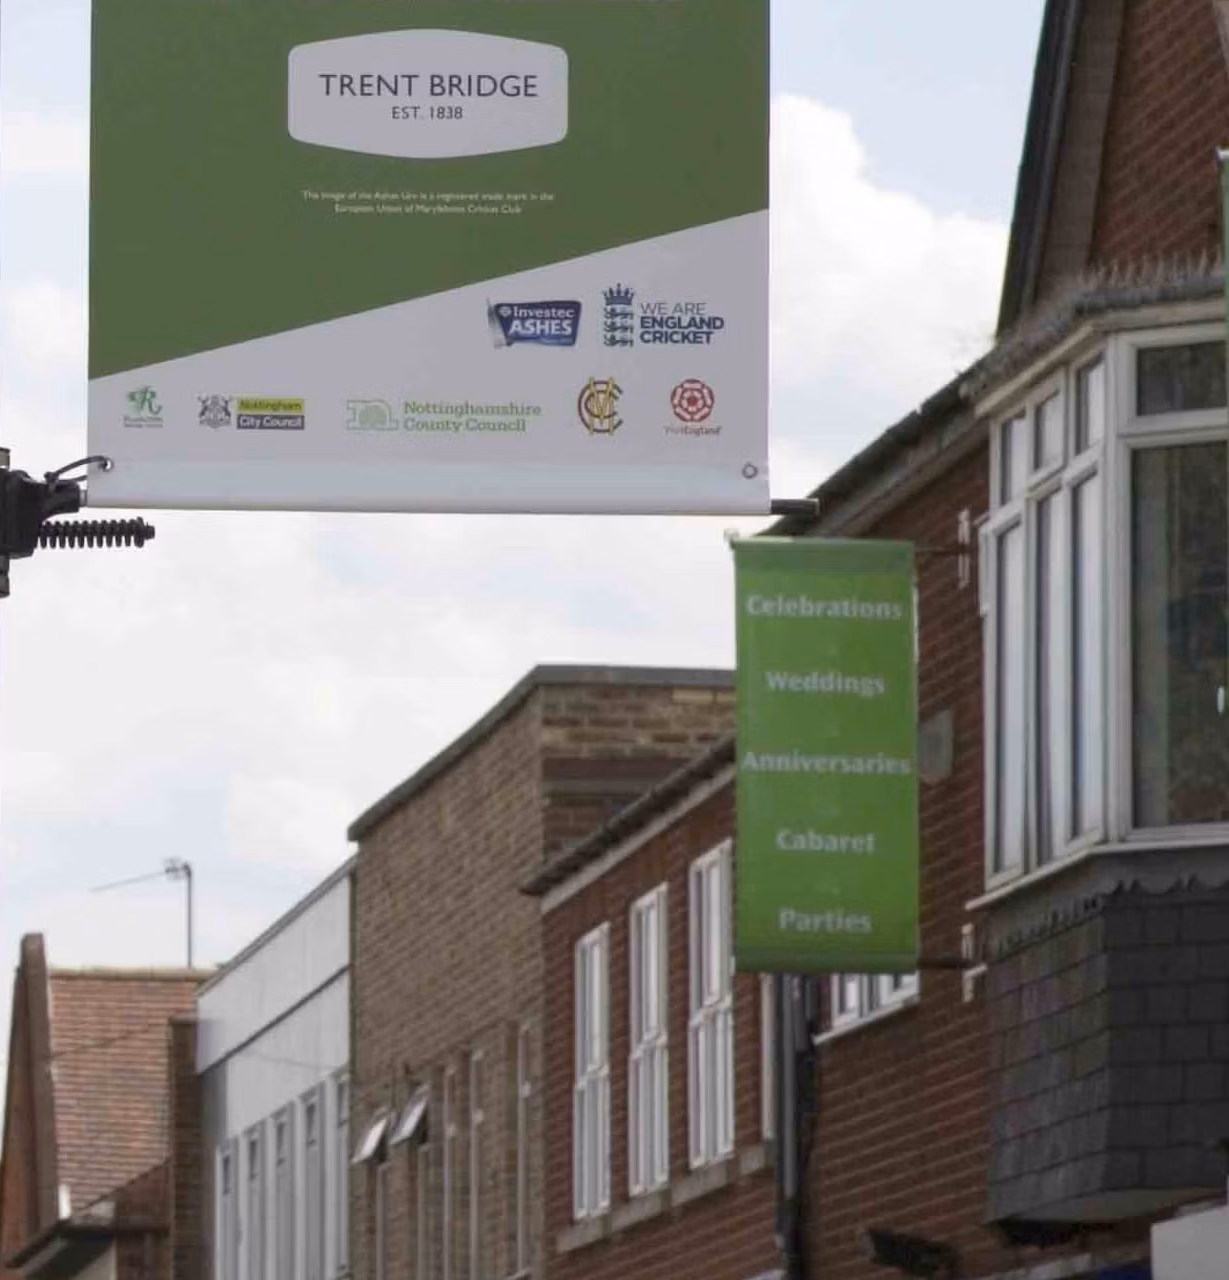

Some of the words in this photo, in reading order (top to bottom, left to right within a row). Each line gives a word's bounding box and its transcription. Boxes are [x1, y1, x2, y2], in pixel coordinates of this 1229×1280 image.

[318, 74, 420, 97] TRENT
[429, 74, 539, 98] BRIDGE
[391, 106, 423, 120] EST.
[429, 106, 463, 120] 1838
[513, 306, 575, 318] Investec
[640, 303, 667, 316] WE
[671, 303, 707, 316] ARE
[508, 319, 572, 335] ASHES
[640, 316, 725, 330] ENGLAND
[640, 330, 715, 345] CRICKET
[404, 401, 541, 417] Nottinghamshire
[404, 418, 462, 432] County
[465, 418, 526, 432] Council
[745, 594, 903, 619] Celebrations
[766, 670, 885, 695] Weddings
[742, 750, 912, 776] Anniversaries
[776, 828, 876, 852] Cabaret
[779, 908, 872, 933] Parties
